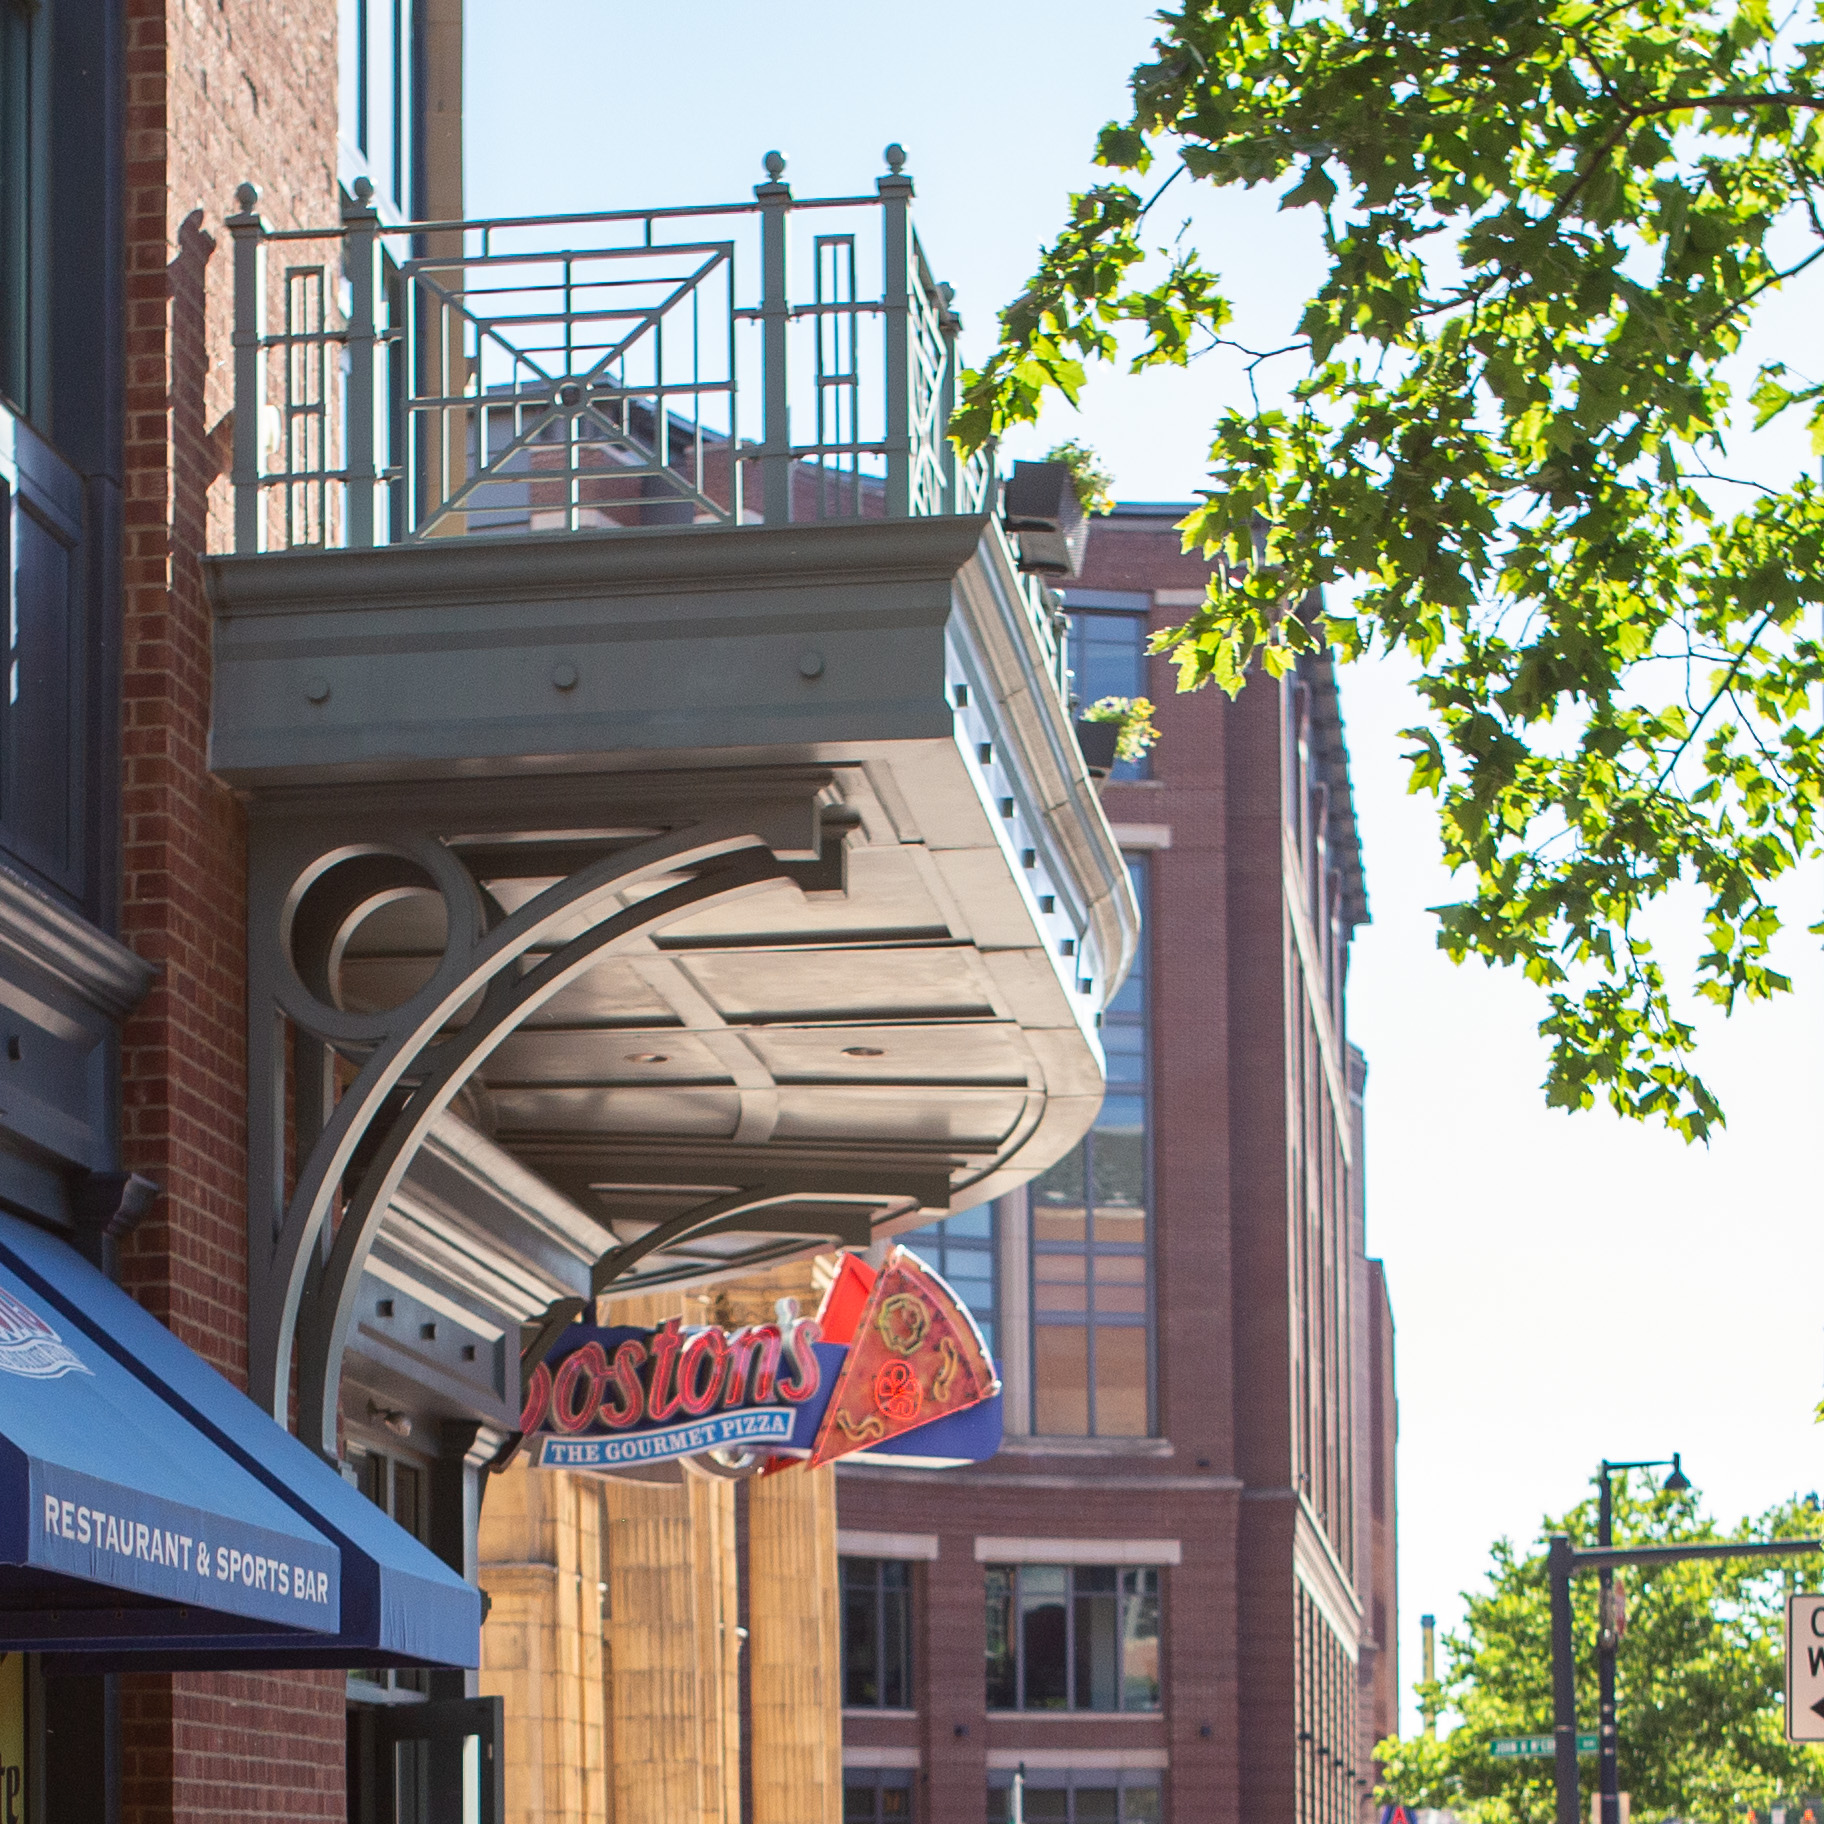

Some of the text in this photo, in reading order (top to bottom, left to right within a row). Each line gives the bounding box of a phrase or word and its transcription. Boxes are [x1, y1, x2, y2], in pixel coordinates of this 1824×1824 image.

[520, 1297, 822, 1438] oston's
[552, 1416, 787, 1464] THE GOURMET PIZZA
[43, 1494, 329, 1605] RESTAURANT & SPORTS BAR
